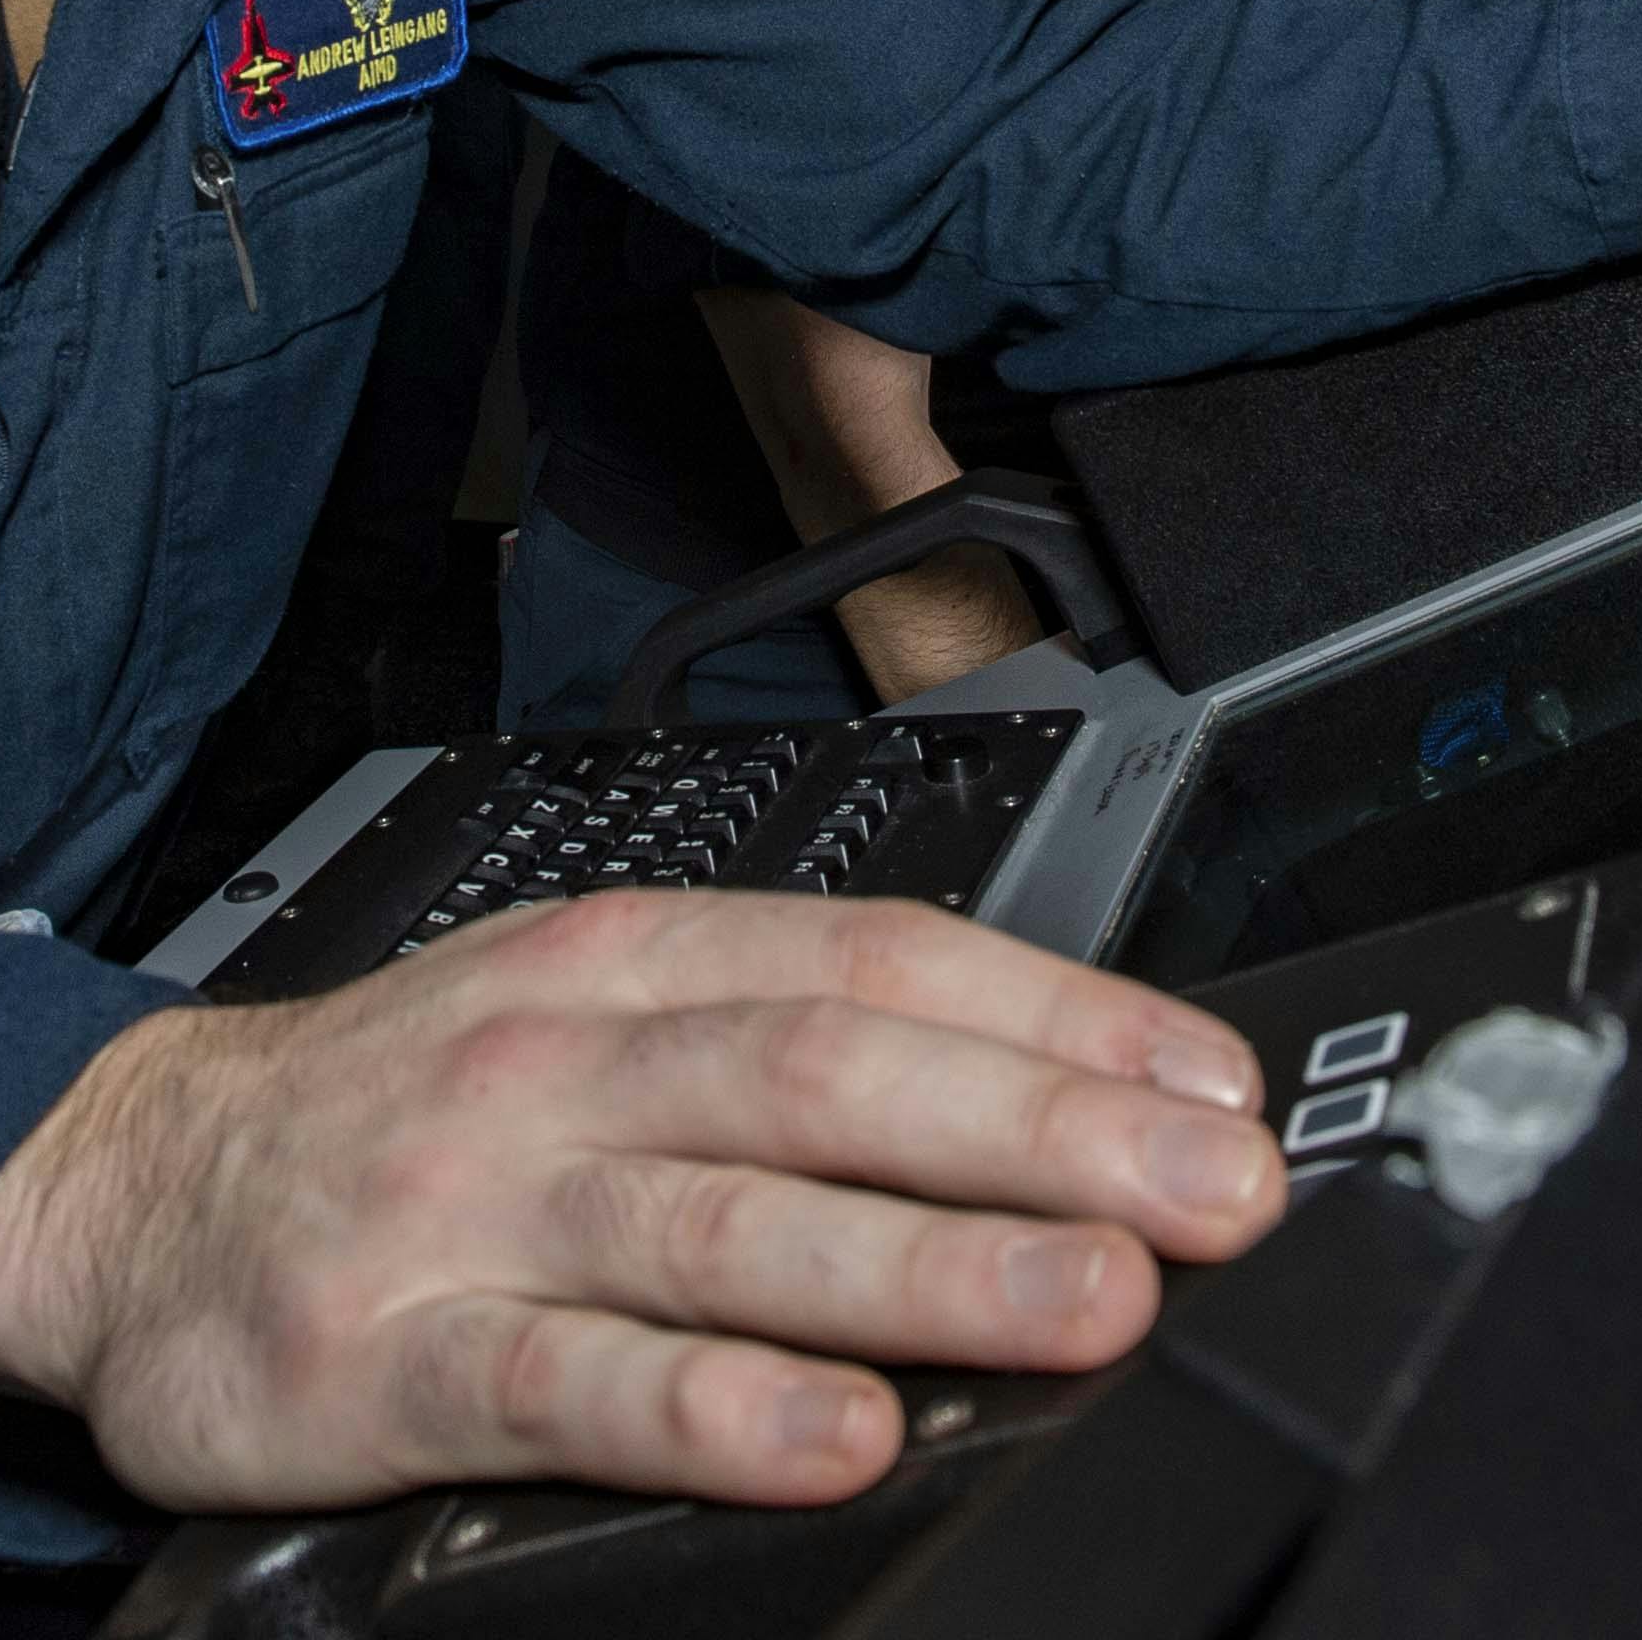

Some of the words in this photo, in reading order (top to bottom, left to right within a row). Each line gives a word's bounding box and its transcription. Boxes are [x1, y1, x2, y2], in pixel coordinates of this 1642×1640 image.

[296, 34, 367, 82] ANDREW
[369, 8, 449, 56] LEINGANG
[358, 54, 398, 92] AIMD
[672, 778, 700, 790] Q
[852, 778, 873, 790] F1
[604, 789, 631, 801] A
[531, 799, 561, 813] Z
[648, 803, 680, 817] W
[834, 803, 855, 815] F2
[582, 815, 611, 827] S
[506, 823, 537, 840] X
[627, 833, 656, 845] E
[558, 841, 589, 854] D
[481, 852, 510, 868] C
[601, 860, 632, 873] R
[535, 869, 563, 882] F
[456, 881, 487, 897] V
[426, 909, 457, 926] B
